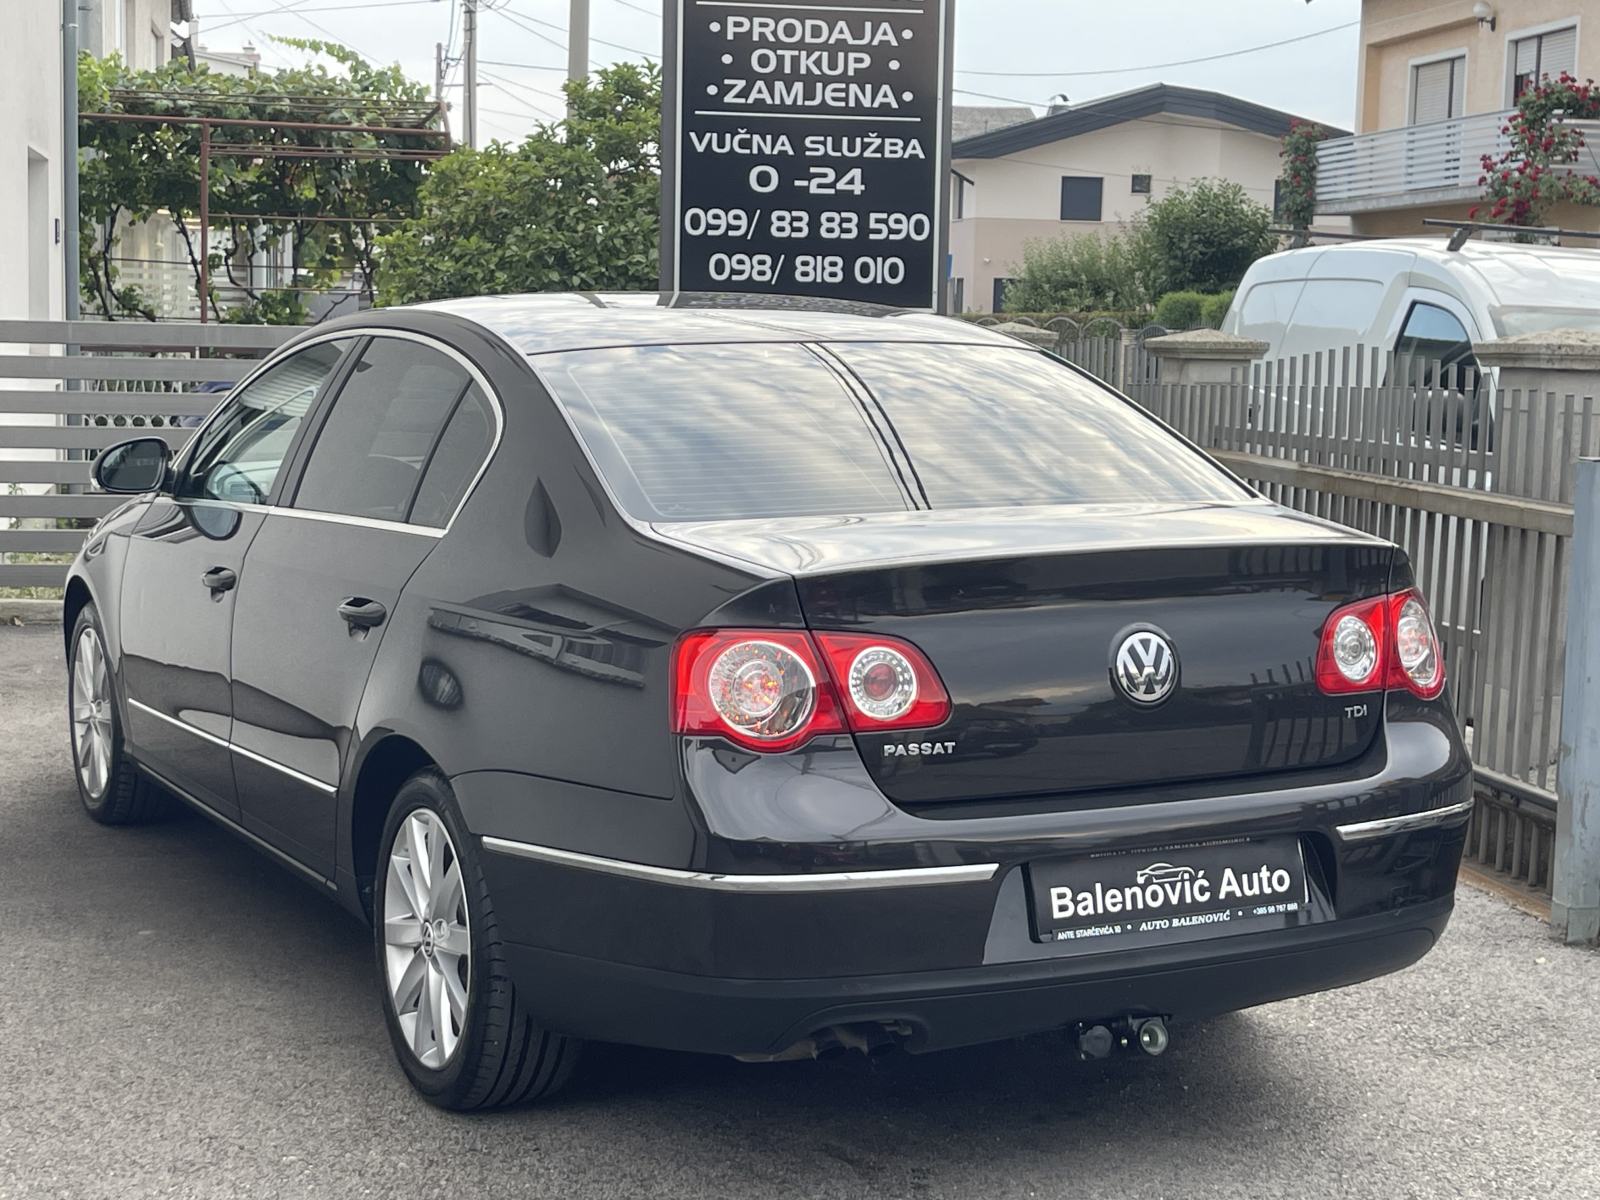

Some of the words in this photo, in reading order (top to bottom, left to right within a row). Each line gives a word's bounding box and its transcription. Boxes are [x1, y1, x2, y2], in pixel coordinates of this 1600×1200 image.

[726, 15, 899, 46] PRODAJA
[750, 48, 872, 76] OTKUP
[723, 78, 899, 109] ZAMJENA
[689, 128, 795, 156] VUČNA
[804, 132, 926, 159] SLUŽBA
[684, 207, 761, 240] 099/
[770, 210, 809, 238] 83
[819, 211, 859, 239] 83
[868, 212, 930, 241] 590
[708, 253, 785, 285] 098/
[794, 255, 844, 283] 818
[854, 256, 905, 285] 010
[1344, 703, 1368, 719] TDI
[883, 741, 956, 757] PASSAT
[1050, 871, 1210, 918] Balenović
[1219, 864, 1290, 899] Auto
[1139, 919, 1170, 932] AUTO
[1172, 909, 1230, 927] BALENOVIĆ
